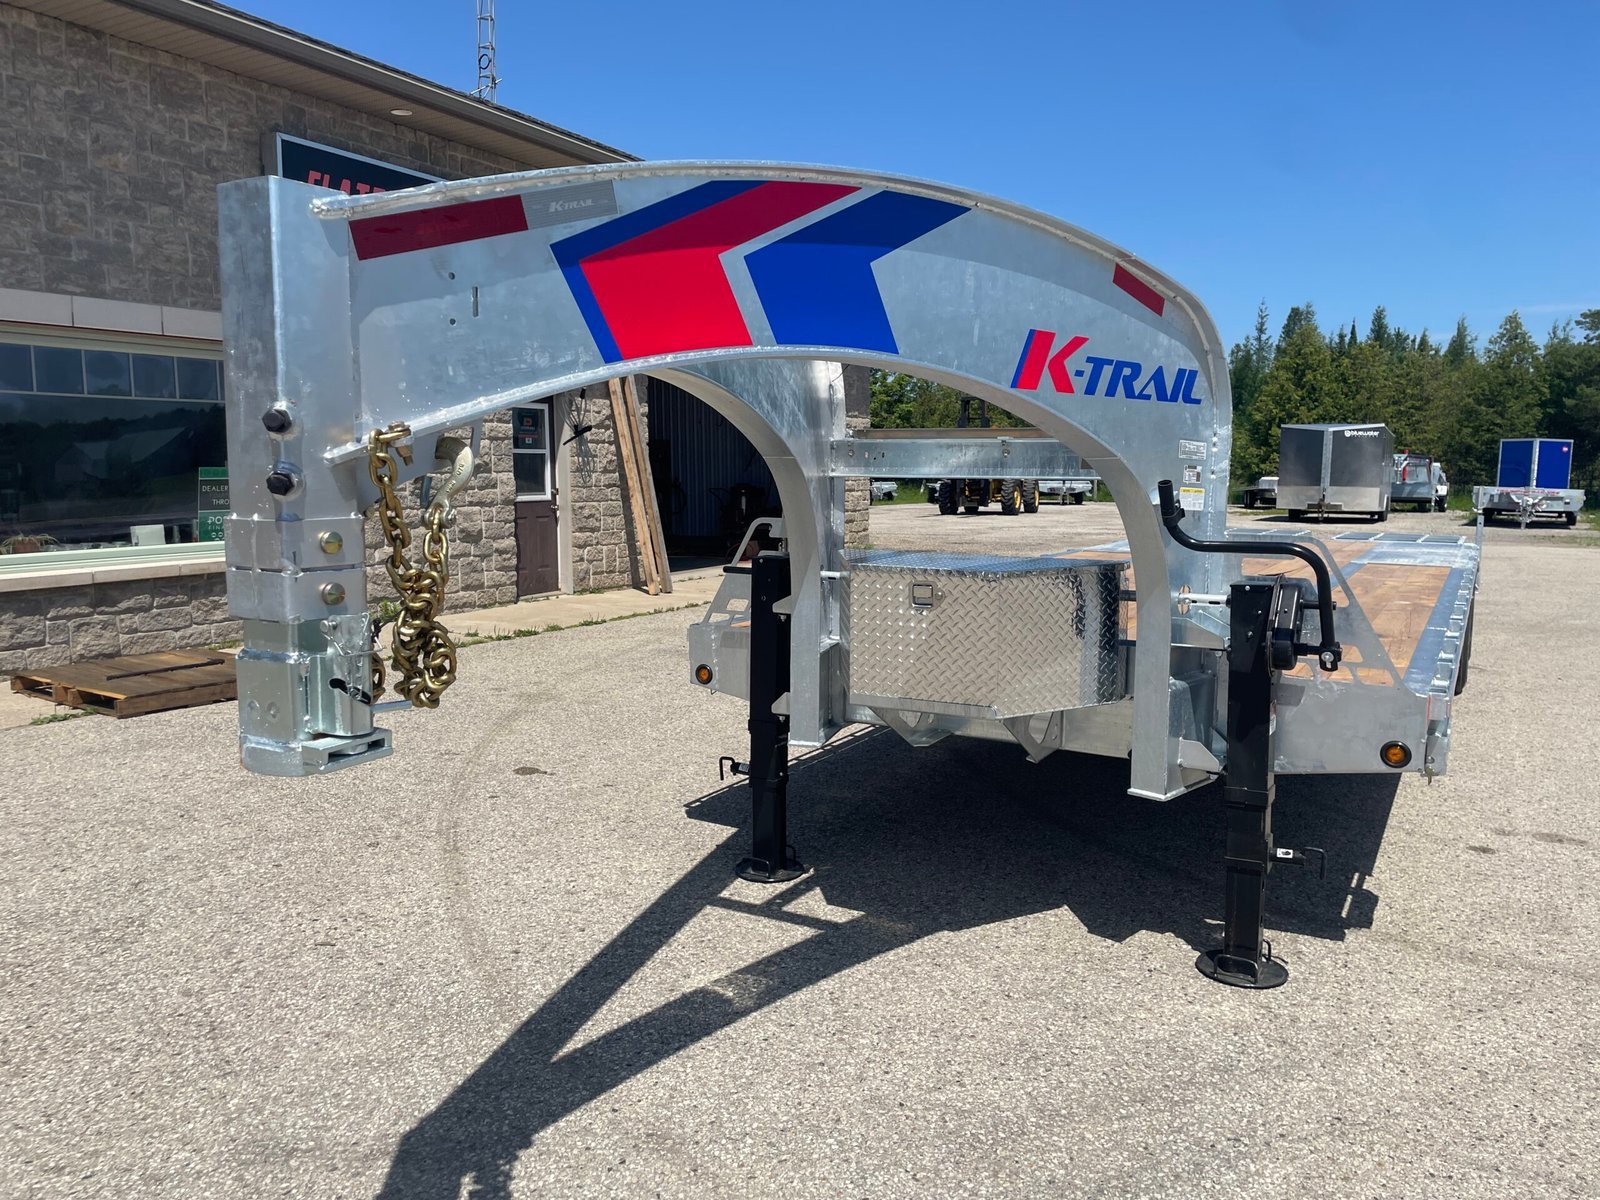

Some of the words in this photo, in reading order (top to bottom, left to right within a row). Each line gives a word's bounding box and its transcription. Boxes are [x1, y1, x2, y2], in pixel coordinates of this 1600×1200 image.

[307, 170, 386, 196] FLAT
[1010, 328, 1202, 405] K-TRAIL
[207, 516, 225, 524] PO
